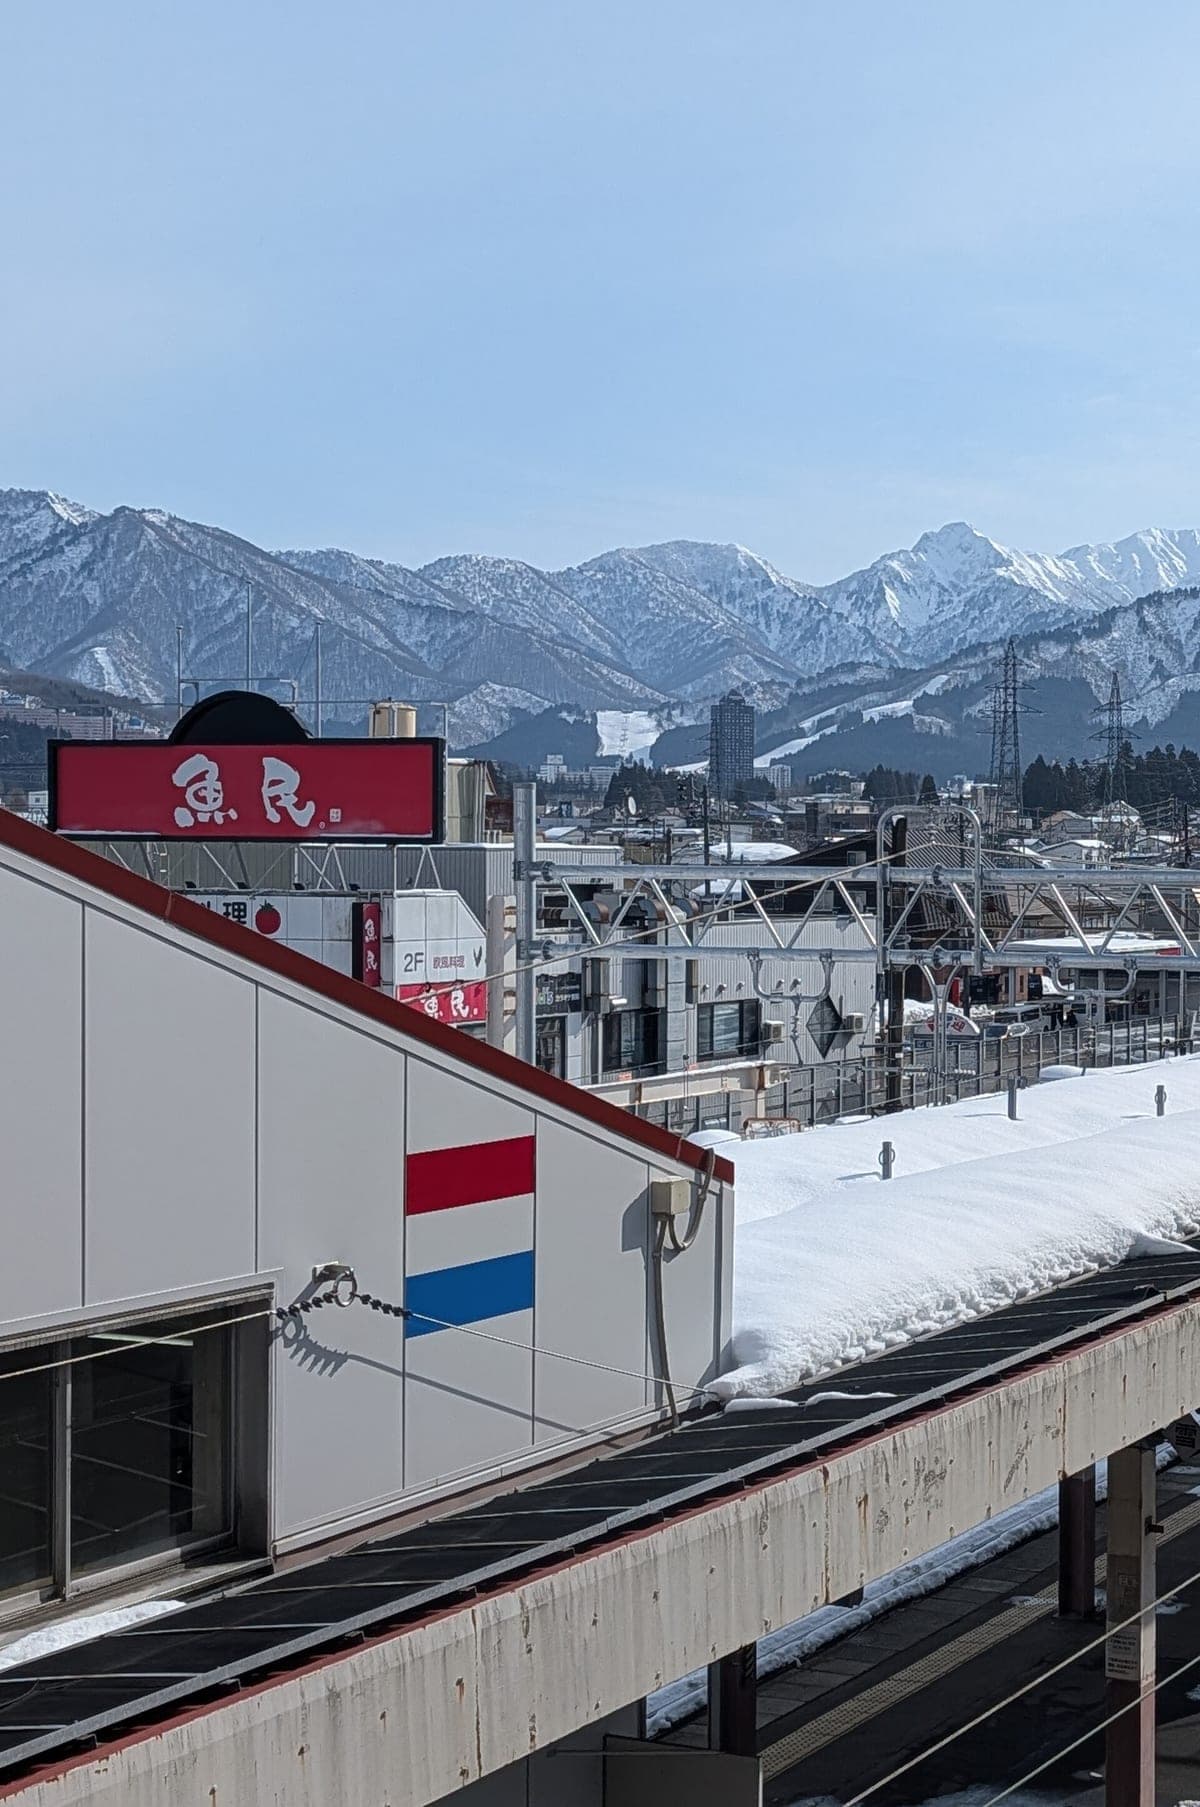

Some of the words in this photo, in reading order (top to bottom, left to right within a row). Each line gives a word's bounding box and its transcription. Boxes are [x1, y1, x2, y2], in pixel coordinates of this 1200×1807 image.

[172, 754, 316, 828] 魚民
[365, 919, 378, 971] 魚民
[404, 953, 424, 972] 2F
